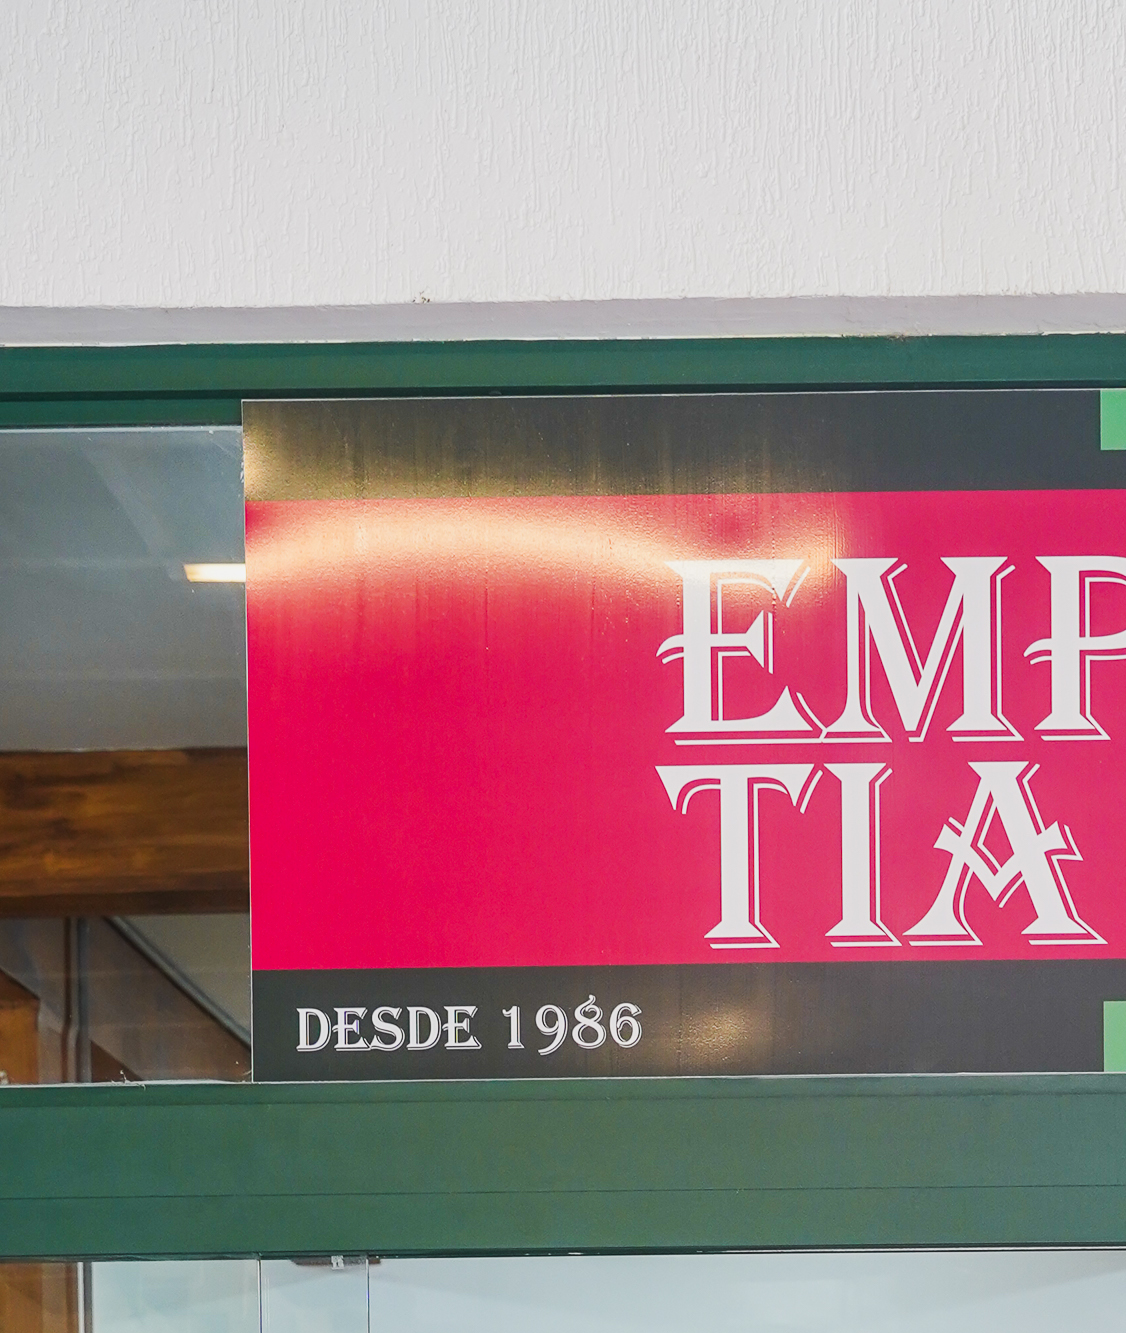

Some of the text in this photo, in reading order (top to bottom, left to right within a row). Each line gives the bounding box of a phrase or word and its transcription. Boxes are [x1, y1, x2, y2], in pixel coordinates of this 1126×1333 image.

[656, 757, 1108, 950] TIA
[295, 992, 645, 1055] DESDE 1986
